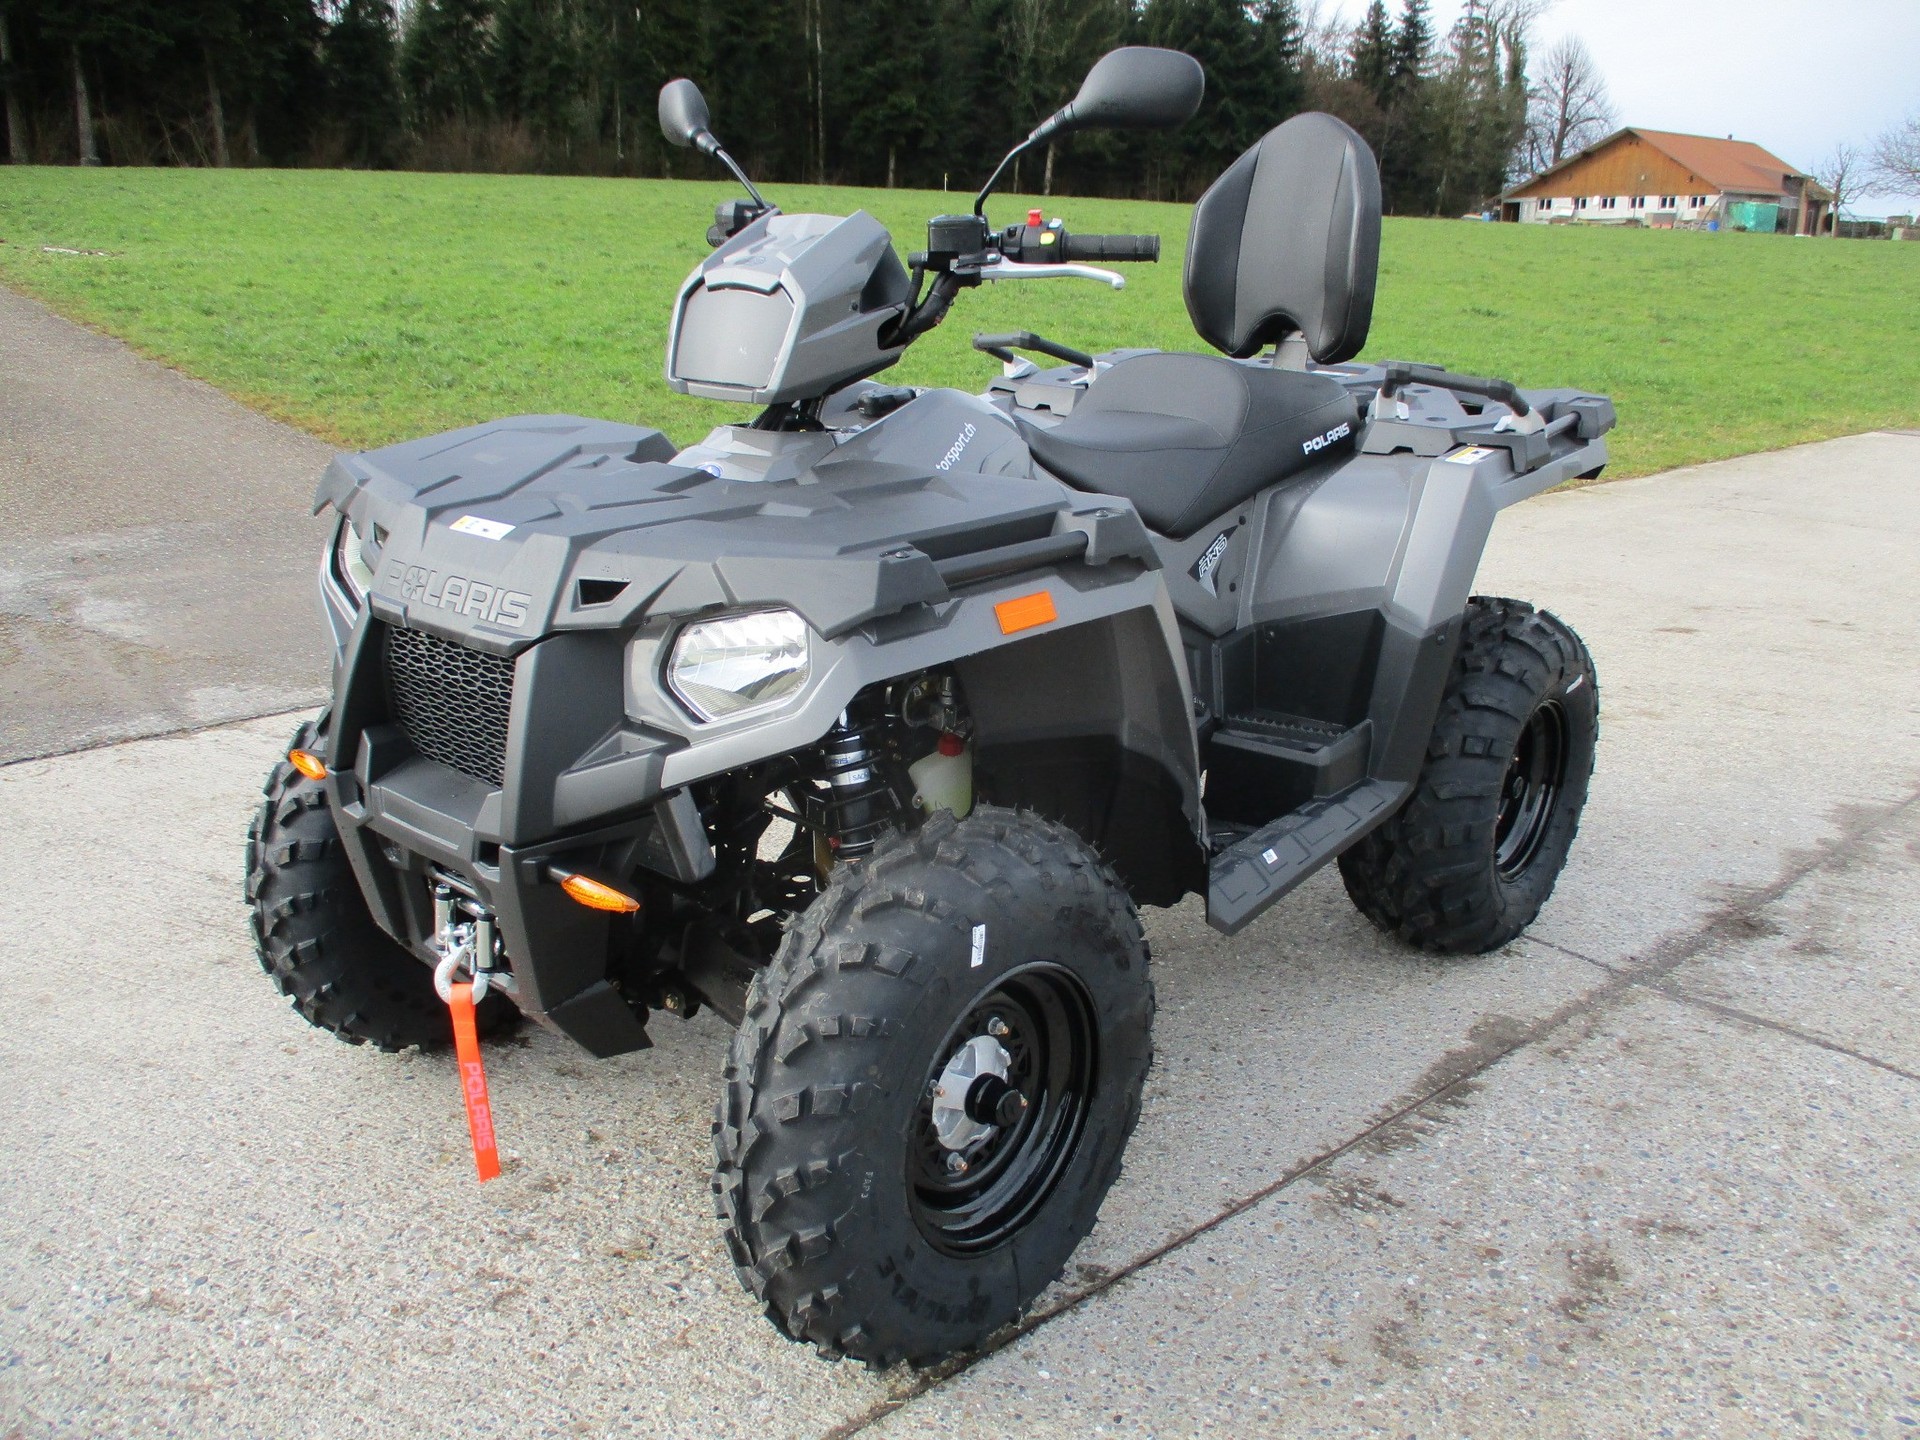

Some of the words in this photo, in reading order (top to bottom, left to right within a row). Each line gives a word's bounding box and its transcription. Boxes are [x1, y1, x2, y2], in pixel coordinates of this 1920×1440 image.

[1303, 422, 1350, 455] POLARIS
[382, 559, 532, 628] POLARIS
[463, 1062, 494, 1151] POLARIS
